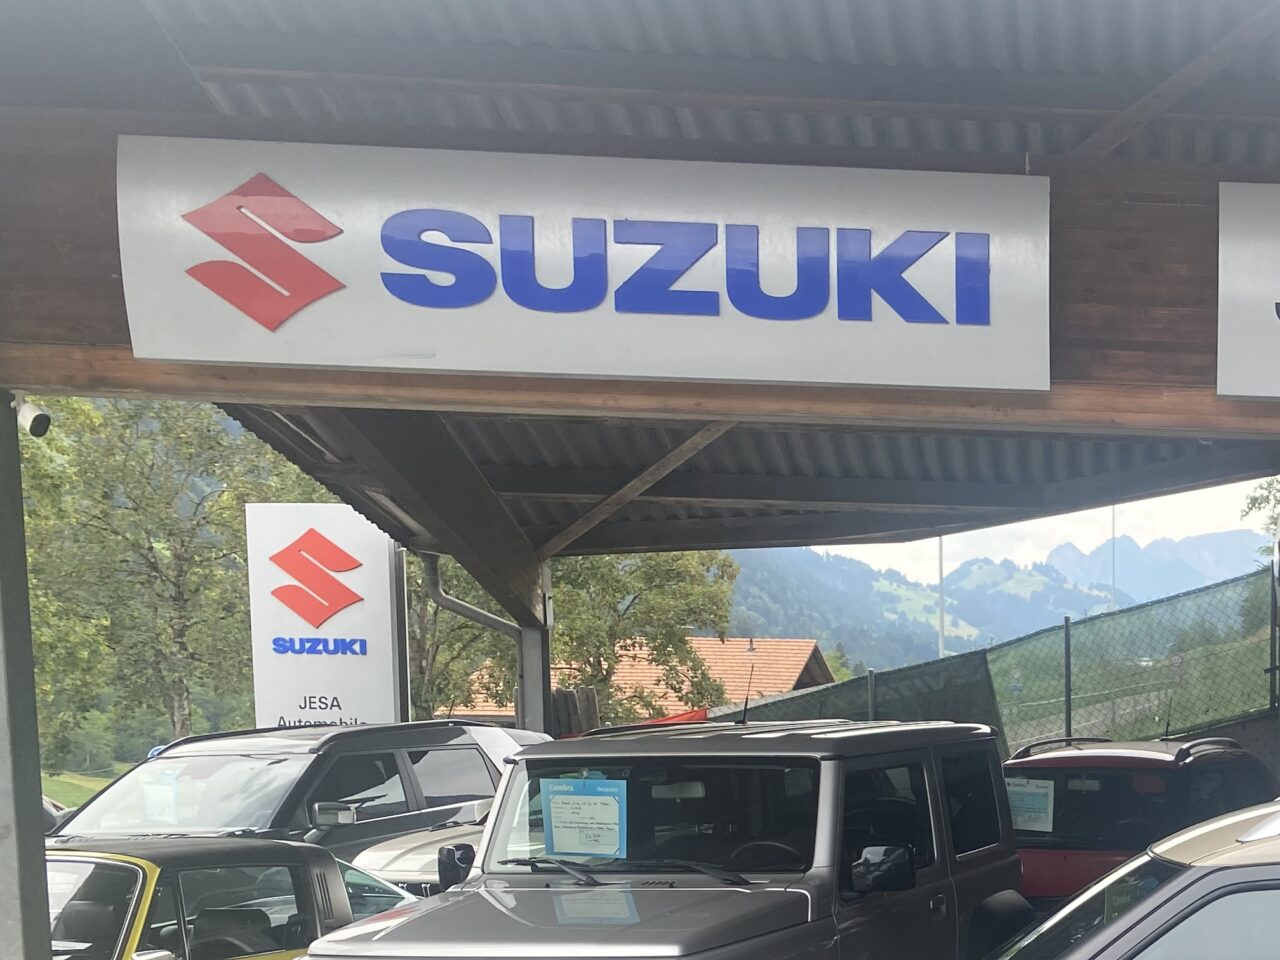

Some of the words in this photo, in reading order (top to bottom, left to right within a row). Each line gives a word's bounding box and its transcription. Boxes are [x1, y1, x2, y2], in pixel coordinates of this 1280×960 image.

[379, 207, 992, 327] SUZUKI
[271, 636, 368, 656] SUZUKI
[298, 695, 343, 711] JESA
